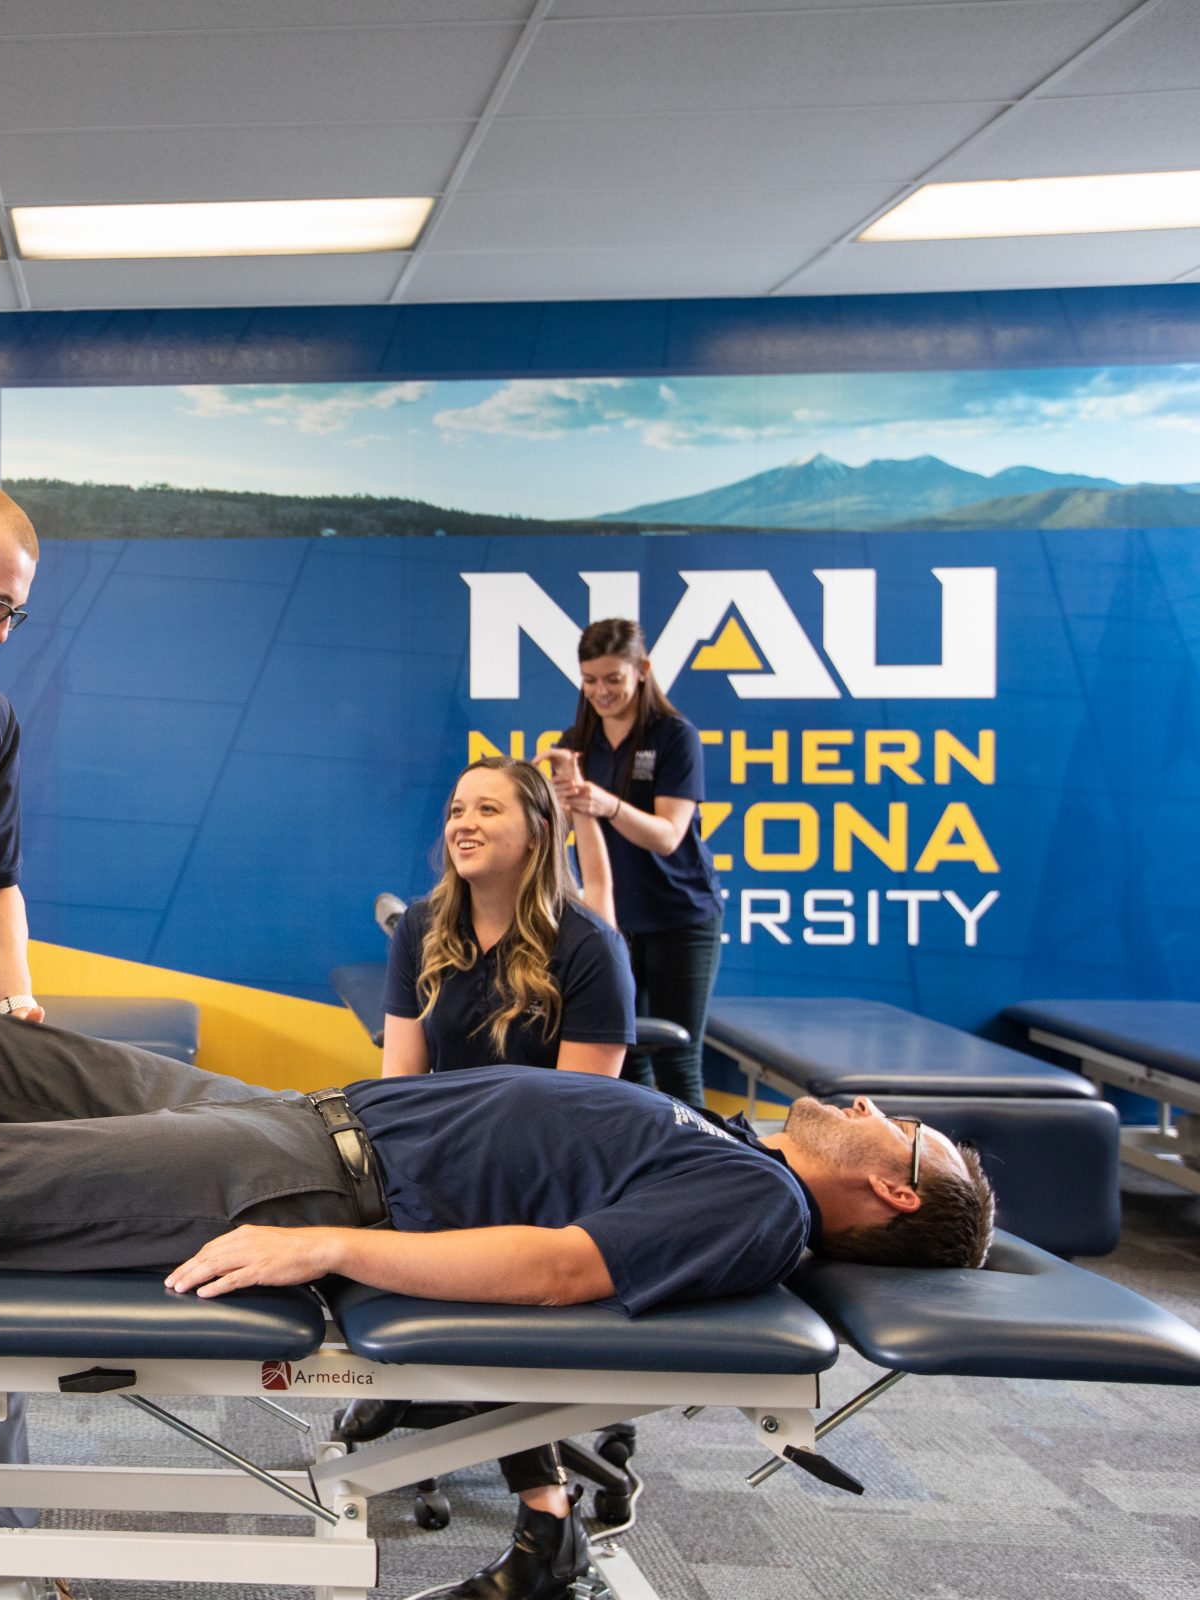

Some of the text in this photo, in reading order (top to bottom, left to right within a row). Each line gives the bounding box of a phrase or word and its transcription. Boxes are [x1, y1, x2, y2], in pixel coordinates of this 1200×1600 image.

[460, 567, 997, 699] NAU
[468, 730, 996, 785] NHERN
[294, 1370, 373, 1384] Armedica
